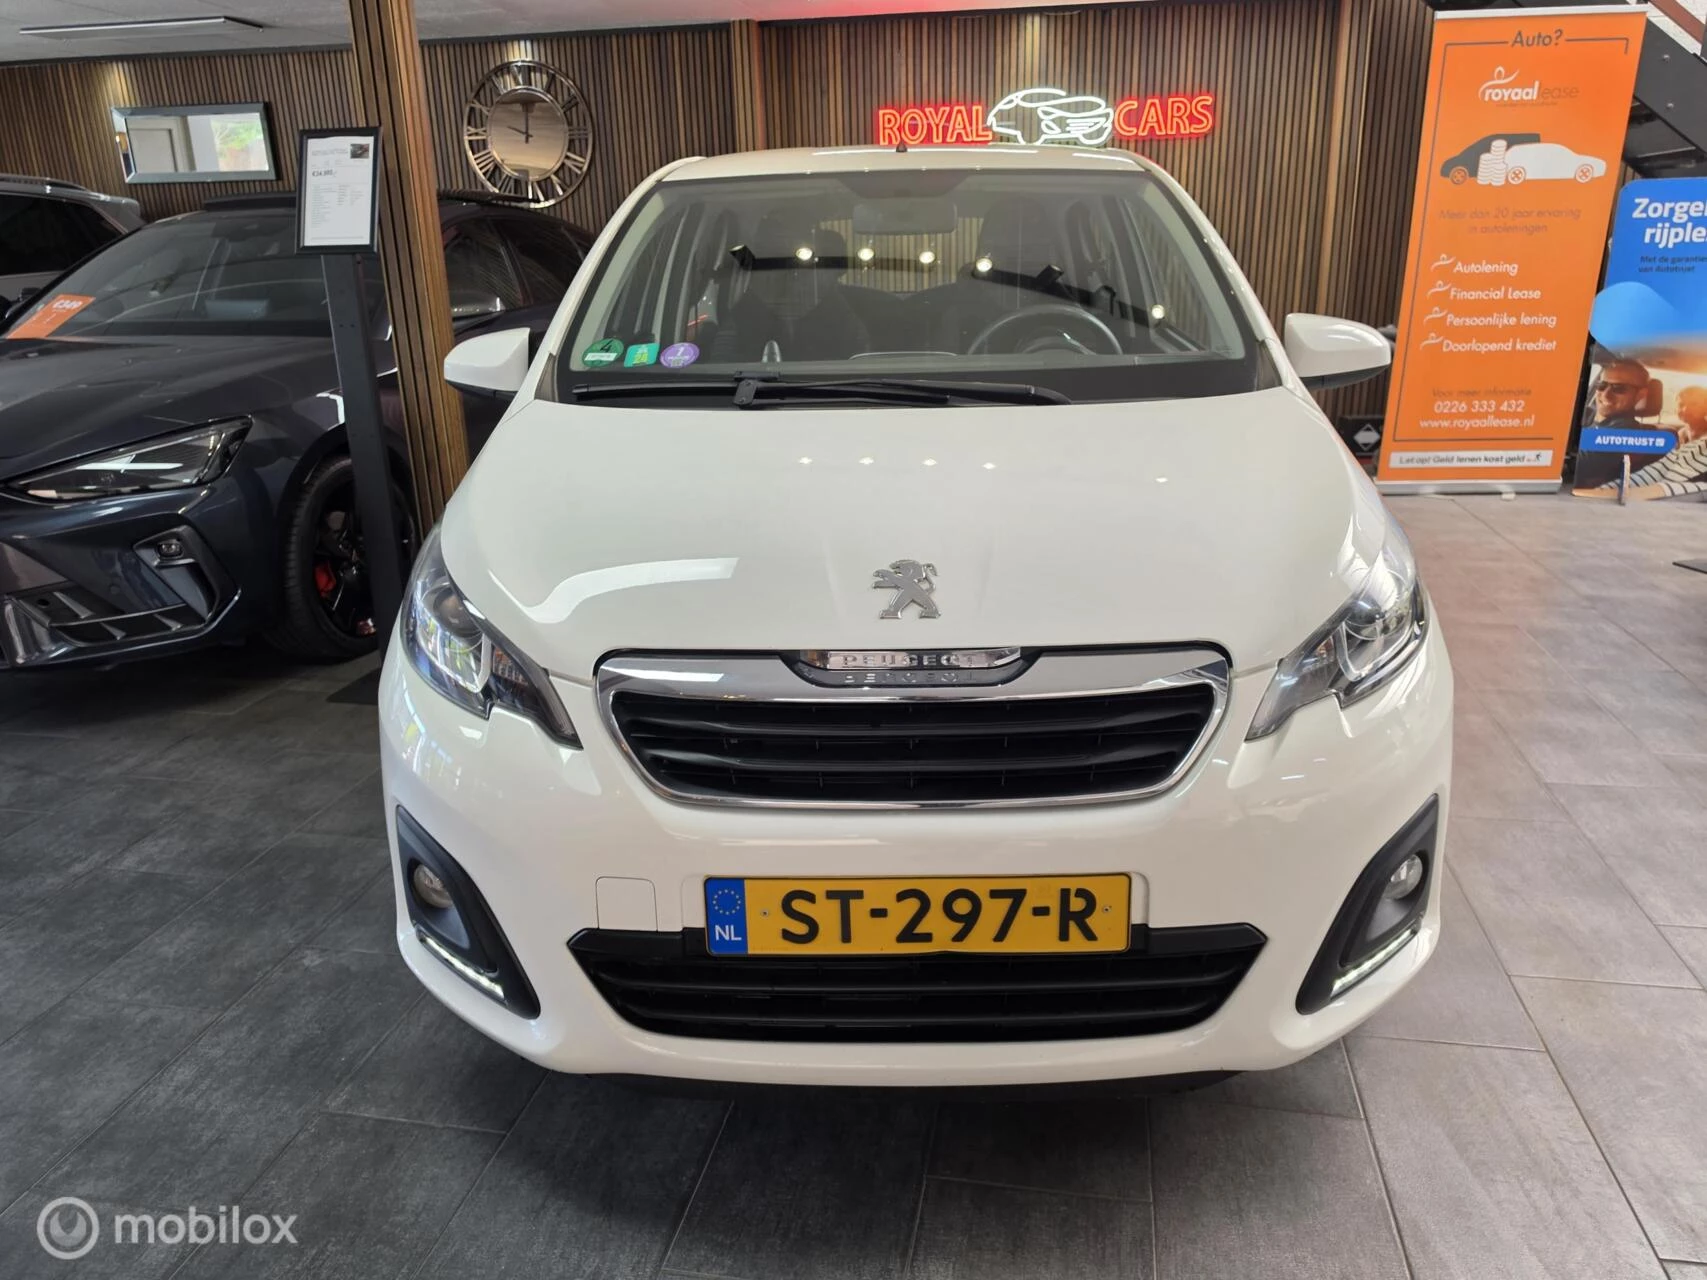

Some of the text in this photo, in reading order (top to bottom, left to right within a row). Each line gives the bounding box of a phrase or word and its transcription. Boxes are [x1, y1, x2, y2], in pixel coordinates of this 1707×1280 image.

[1511, 28, 1563, 47] Auto?
[878, 95, 1213, 145] ROYAL CARS
[1536, 208, 1582, 222] ervaring
[1644, 221, 1707, 249] rijple
[1453, 260, 1518, 276] Autolening
[1450, 286, 1541, 300] Financial Lease
[1446, 311, 1557, 328] Persoonlijke lening
[1442, 337, 1557, 354] Doorlopend krediet
[1434, 400, 1525, 414] 0226 333 432
[1419, 414, 1536, 431] www.royaallease.nl
[1595, 436, 1655, 446] AUTOTRUST
[1433, 453, 1455, 464] Geld
[1456, 453, 1482, 464] lenen
[1484, 452, 1504, 463] kost
[1505, 452, 1526, 466] geld
[780, 887, 1099, 944] ST-297-R
[714, 925, 742, 941] NL
